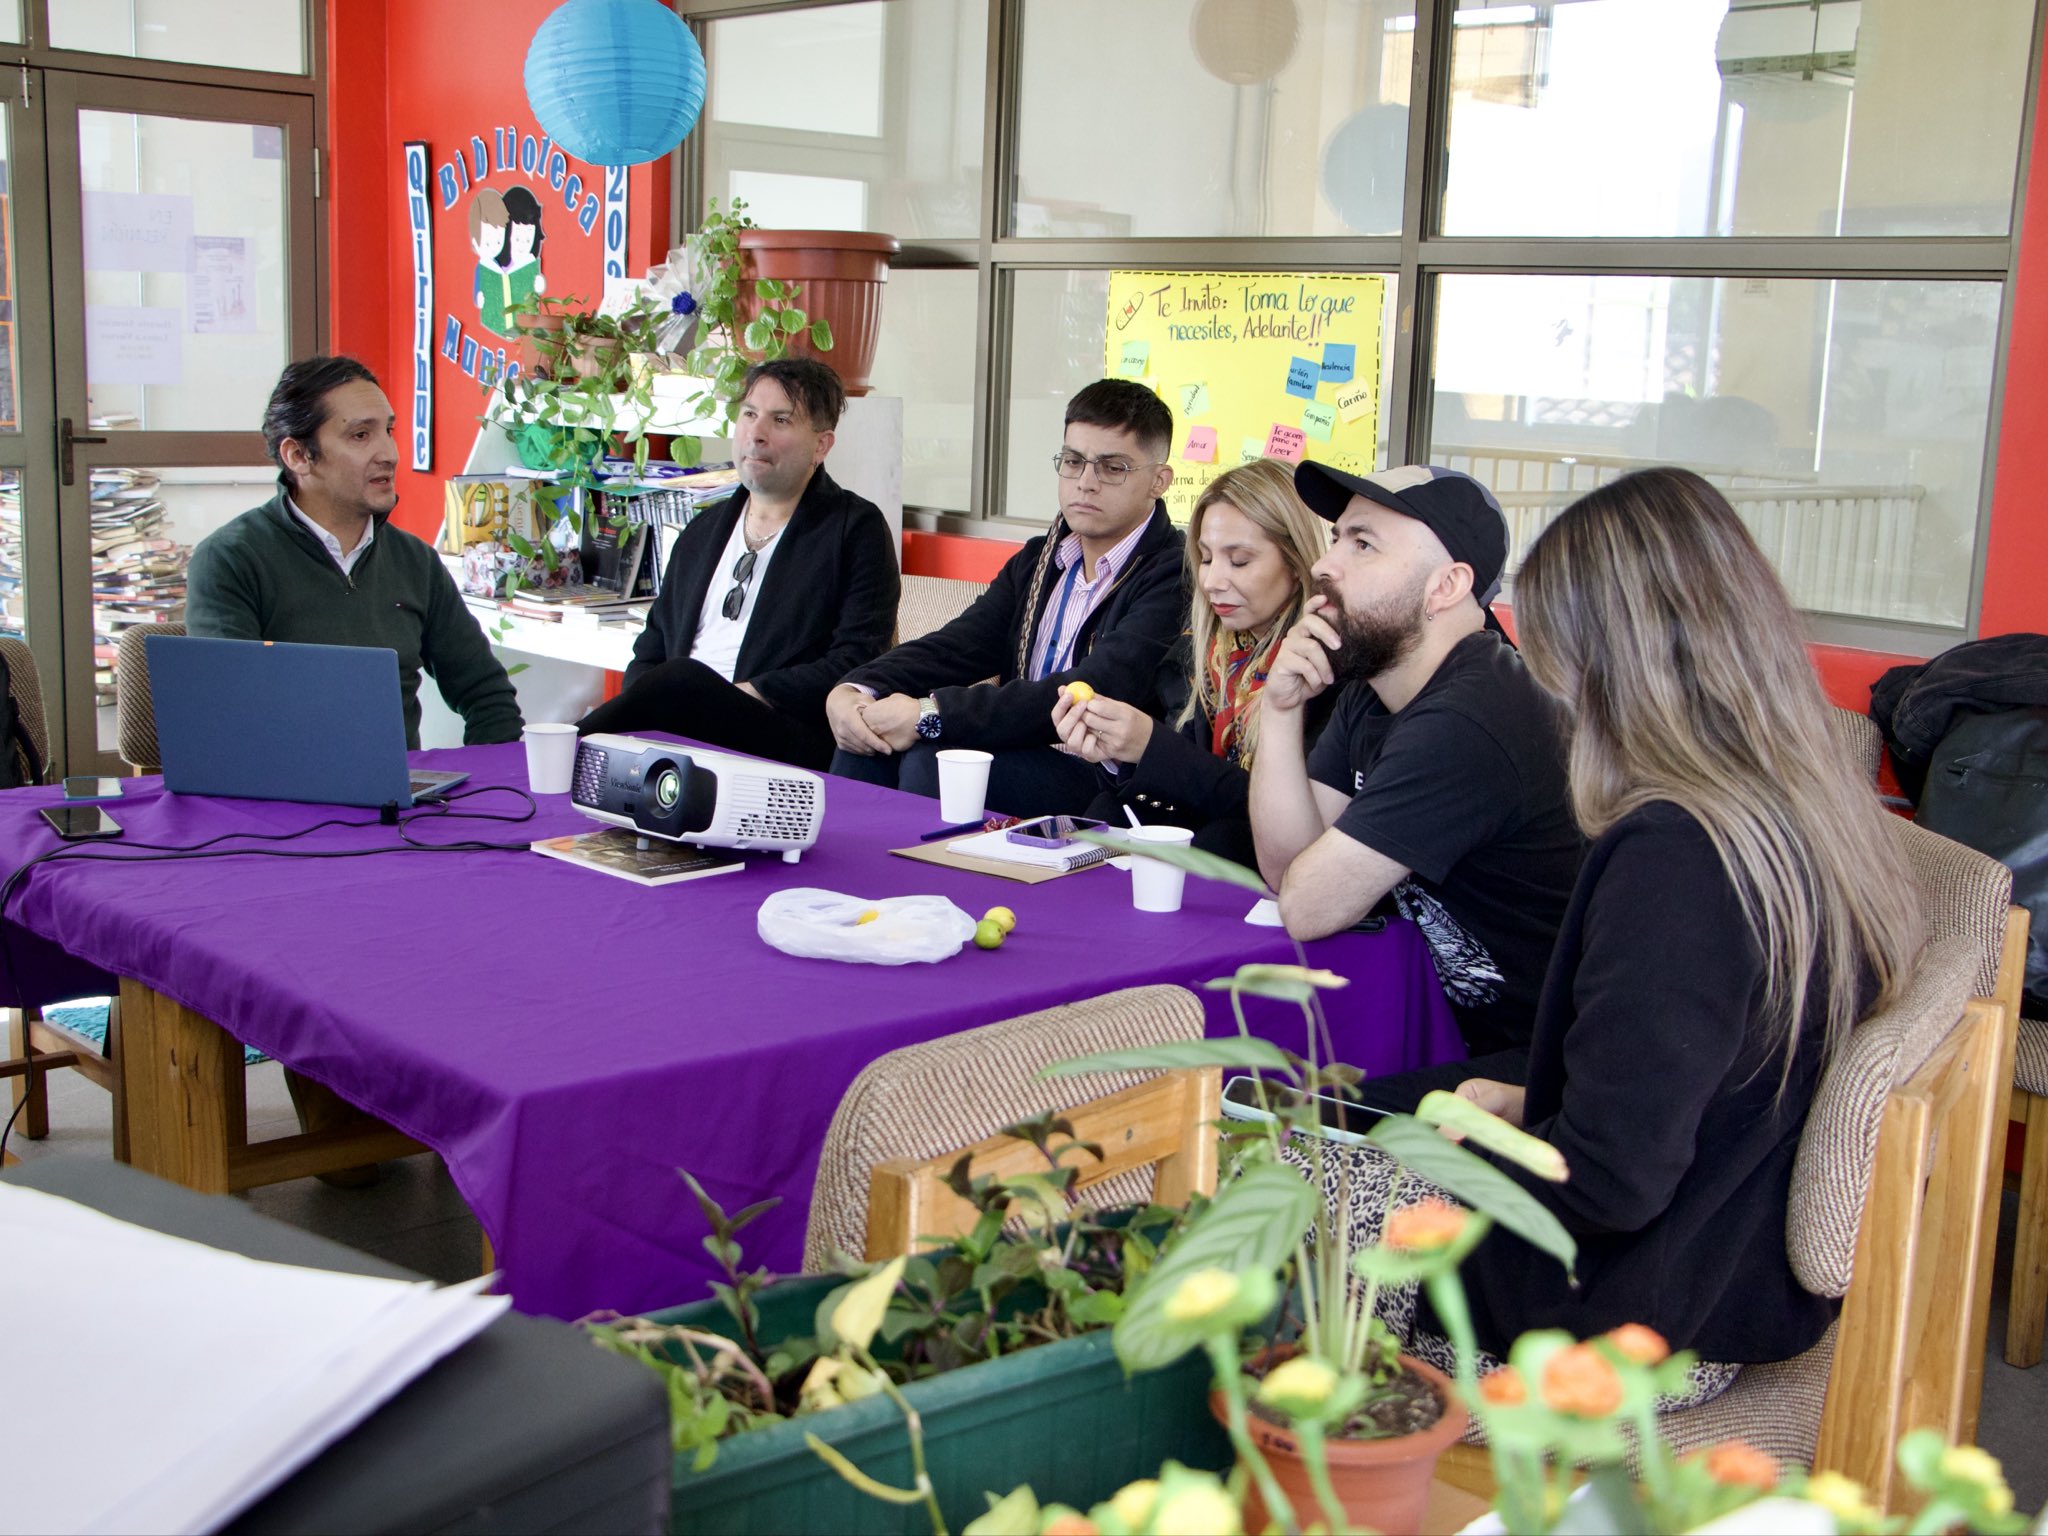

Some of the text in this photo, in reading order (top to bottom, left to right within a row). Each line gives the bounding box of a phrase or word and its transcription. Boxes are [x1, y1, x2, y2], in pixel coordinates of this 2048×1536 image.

[438, 125, 600, 237] Biblioteca
[408, 151, 429, 465] Quirihue
[1149, 282, 1355, 327] Te Invito: Toma lo que
[1168, 314, 1238, 343] necesites,
[442, 314, 520, 386] Munic
[1337, 389, 1368, 410] Cariño
[1269, 444, 1294, 456] Leer
[611, 778, 642, 793] ViewSonic
